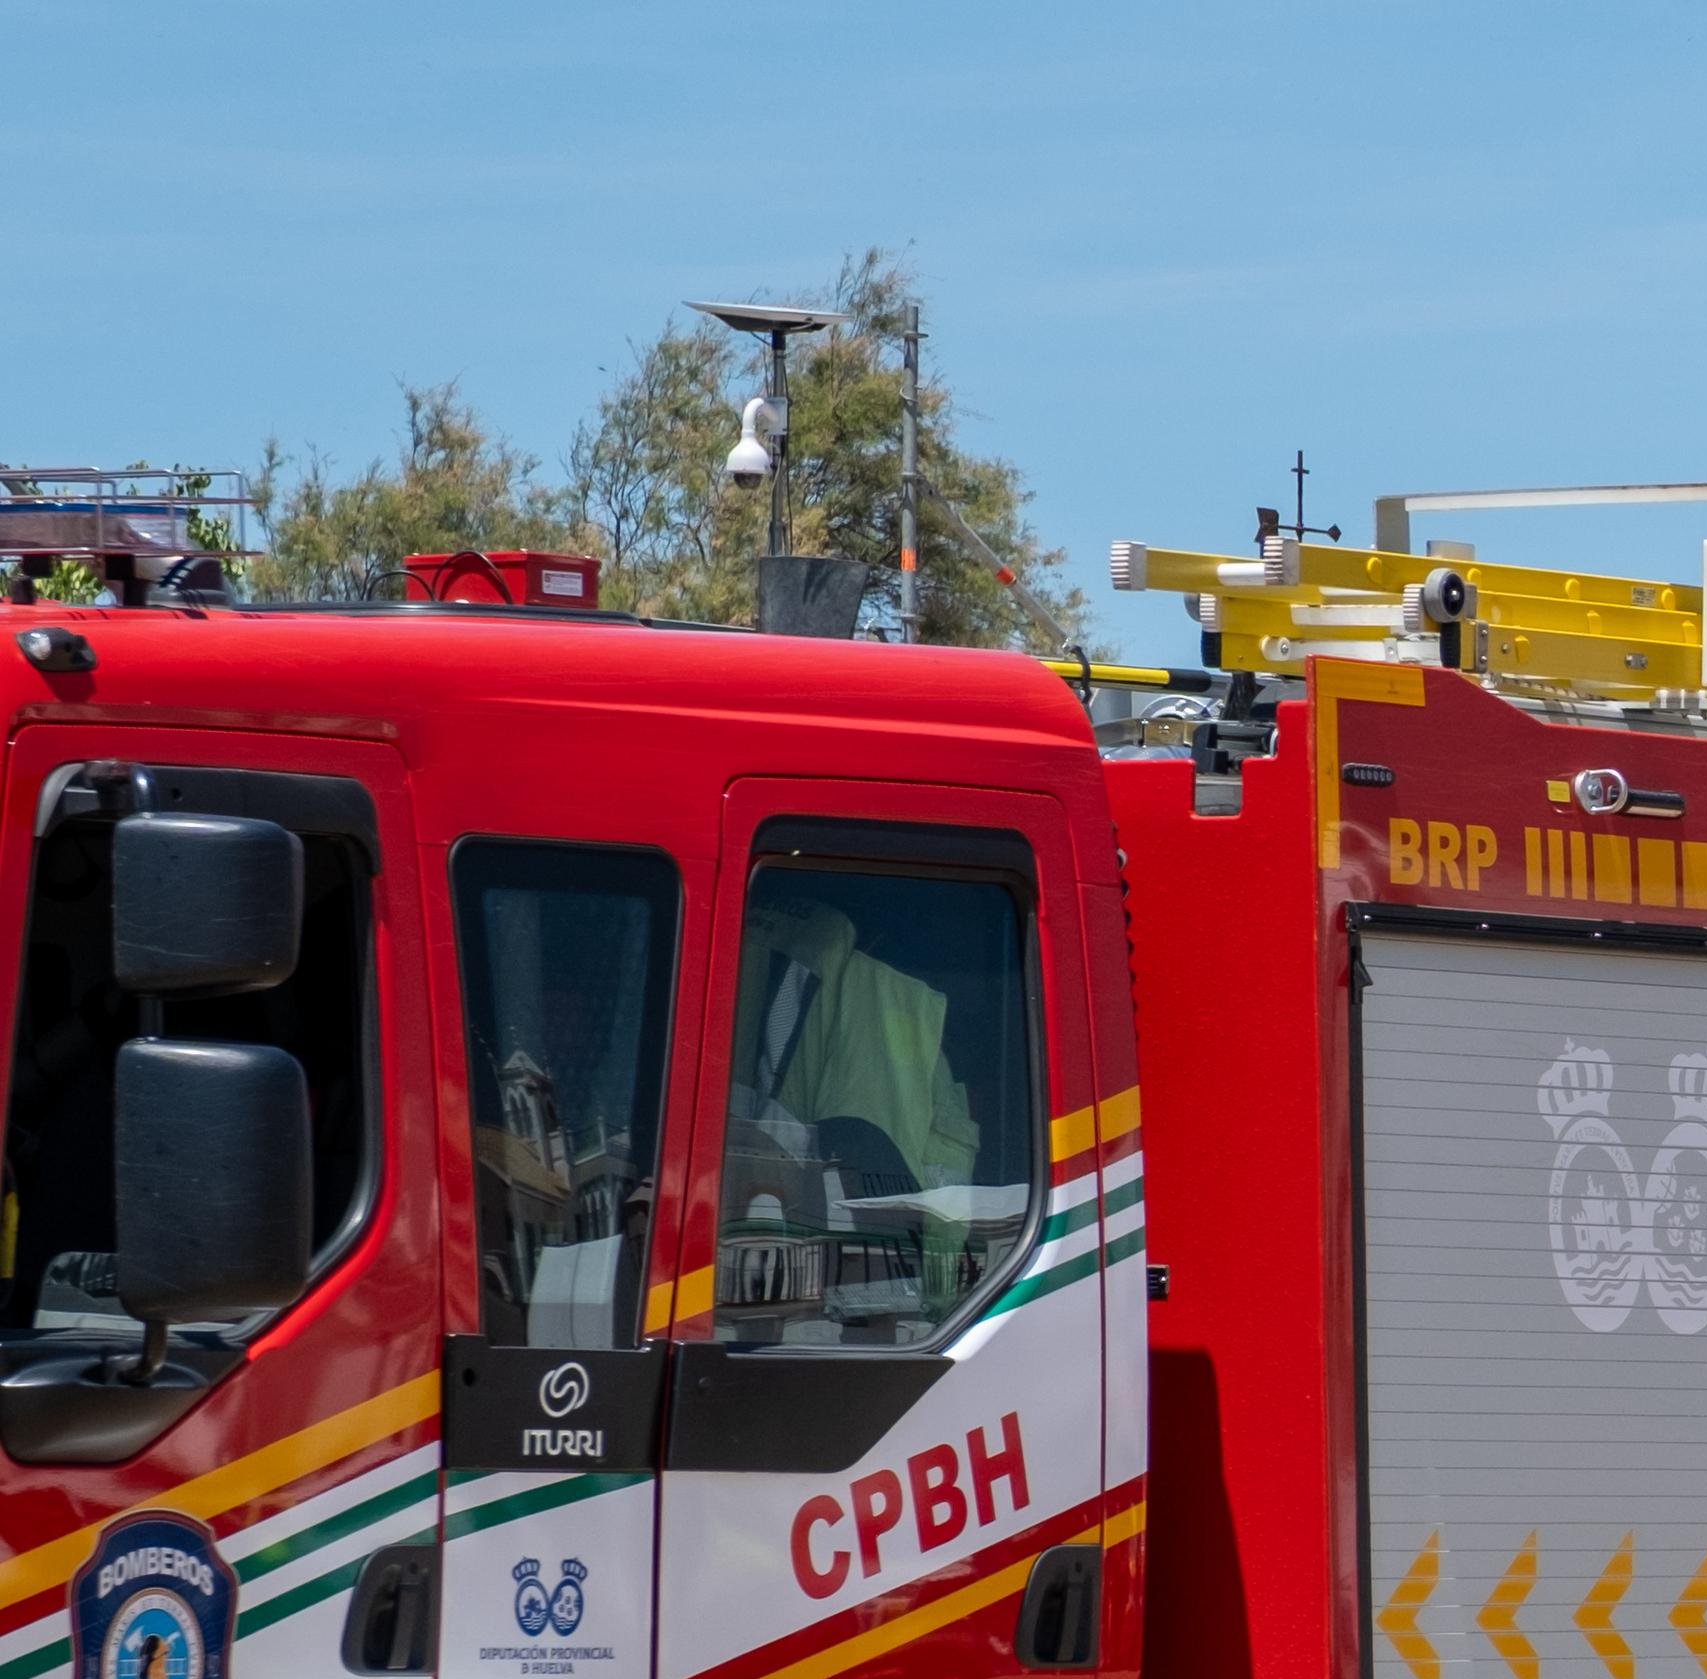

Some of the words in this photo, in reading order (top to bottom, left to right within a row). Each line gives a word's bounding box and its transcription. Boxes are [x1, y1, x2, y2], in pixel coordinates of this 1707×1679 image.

[1389, 817, 1498, 892] BRP
[523, 1429, 602, 1457] ITURRI
[790, 1411, 1031, 1600] CPBH
[98, 1546, 214, 1599] BOMBEROS
